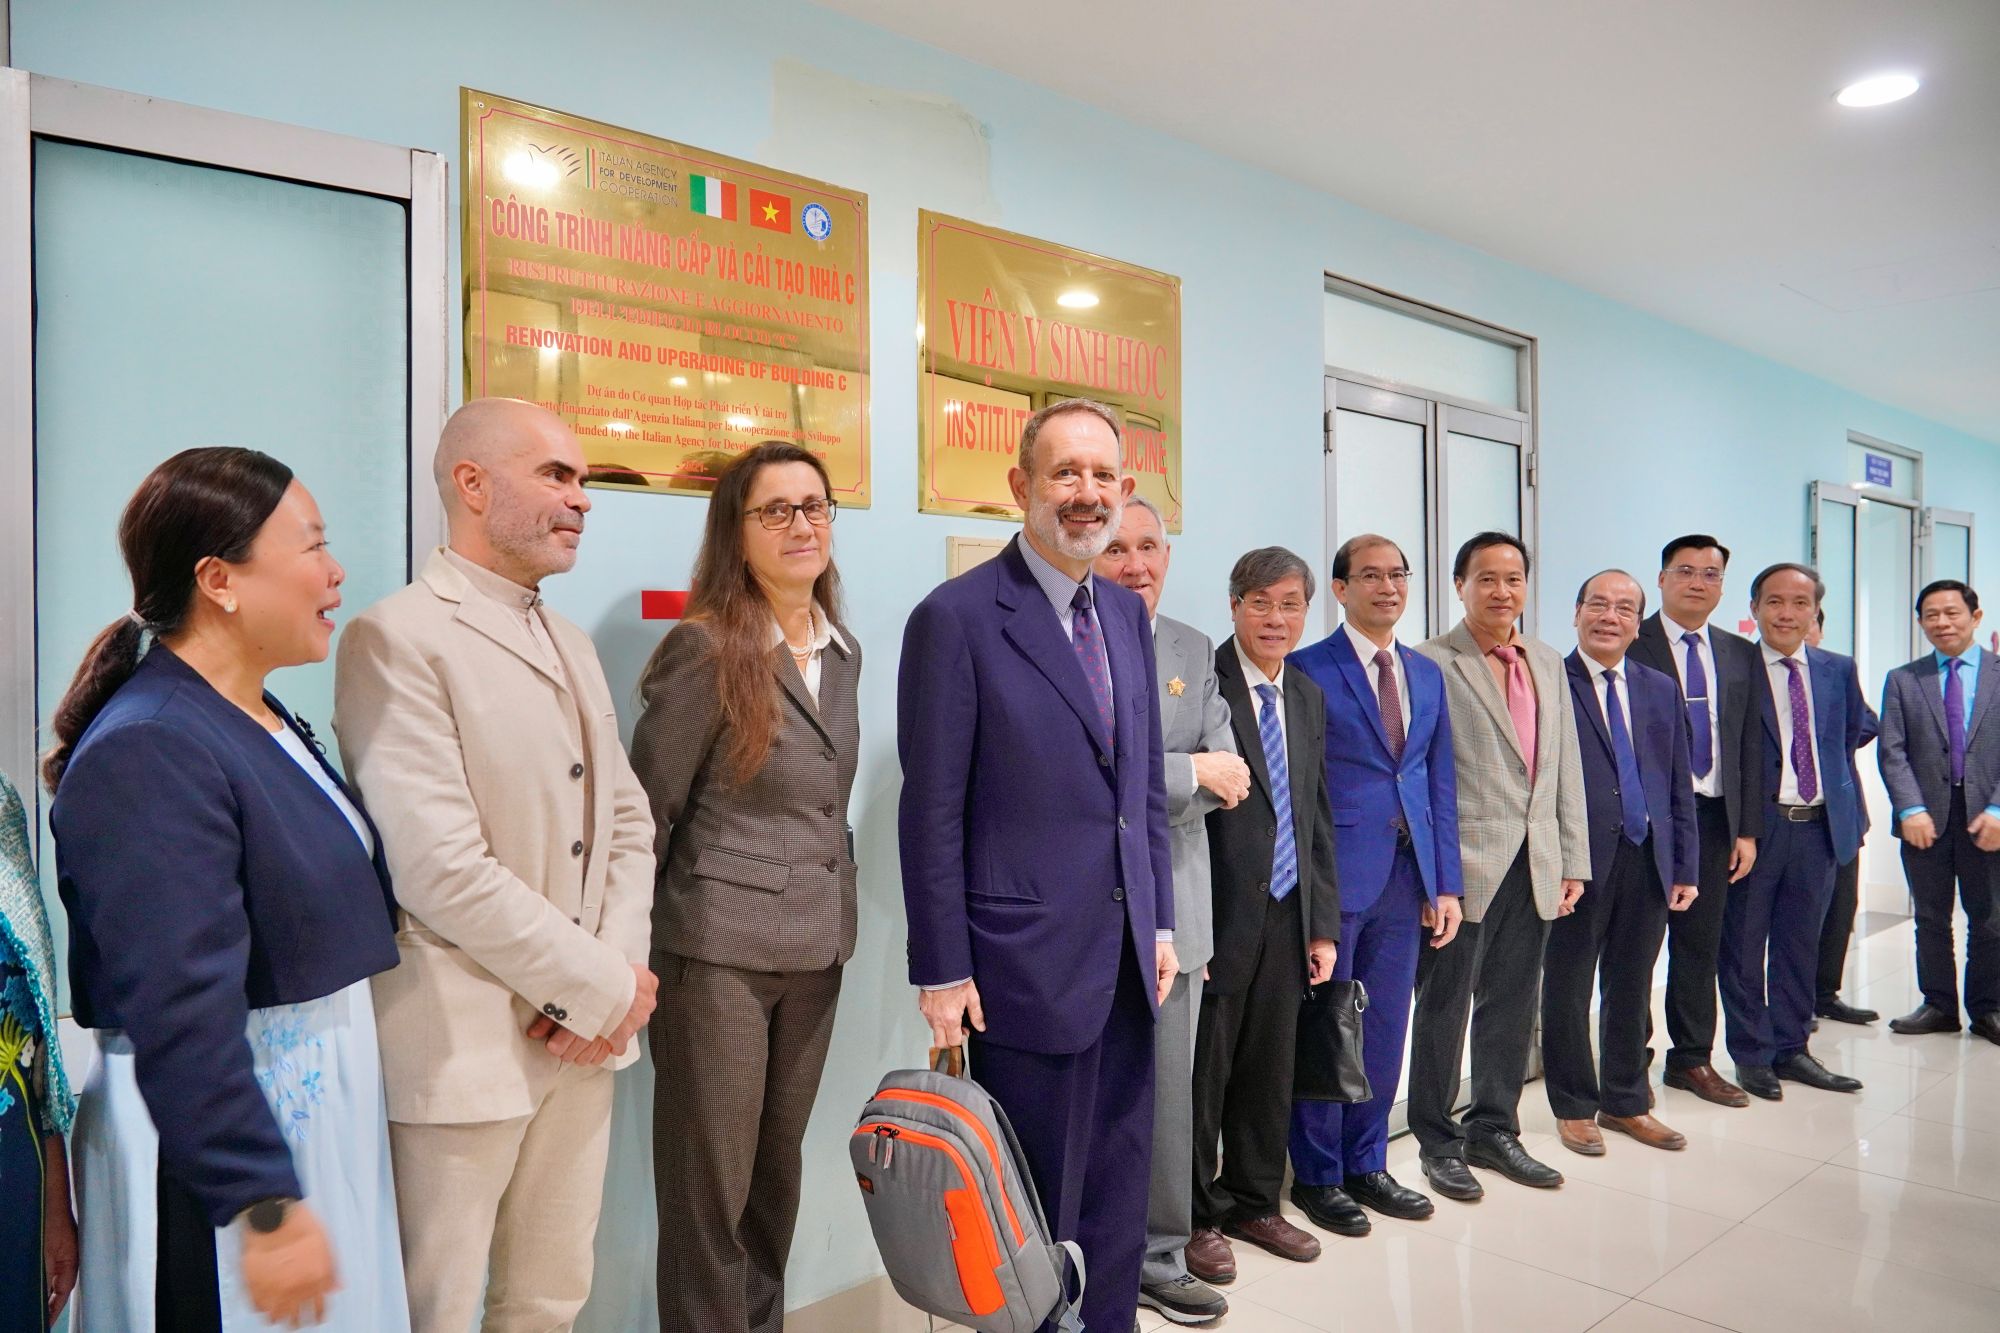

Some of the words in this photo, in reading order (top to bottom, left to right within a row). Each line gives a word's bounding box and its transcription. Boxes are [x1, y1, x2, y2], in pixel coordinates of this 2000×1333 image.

[600, 152, 633, 169] ITALIAN
[636, 161, 677, 179] AGENCY
[600, 167, 615, 178] FOR
[620, 172, 678, 192] DEVELOPMENT
[600, 181, 678, 207] COOPERATION
[491, 194, 549, 246] CÔNG
[555, 209, 613, 258] TRÌNH
[619, 220, 671, 271] NÂNG
[676, 227, 711, 275] CẤP
[717, 240, 739, 282] VÀ
[743, 243, 770, 289] CẢI
[775, 258, 805, 300] TẠO
[809, 264, 841, 303] NHÀ
[845, 273, 855, 305] C
[511, 258, 690, 305] RISTRUTTURAZIONE
[696, 292, 705, 308] E
[711, 296, 843, 333] AGGIORNAMENTO
[705, 319, 770, 346] BLOCCO
[946, 287, 1017, 387] VIỆN
[1023, 315, 1042, 377] Y
[1050, 321, 1110, 390] SINH
[1116, 337, 1167, 412] HỌC
[506, 324, 612, 358] RENOVATION
[618, 342, 652, 363] AND
[658, 347, 744, 376] UPGRADING
[750, 361, 766, 379] OF
[771, 364, 834, 390] BUILDING
[838, 375, 847, 391] C
[587, 384, 601, 400] Dự
[604, 386, 615, 398] án
[618, 388, 630, 400] do
[633, 390, 646, 402] Cơ
[648, 395, 670, 406] quan
[673, 395, 691, 410] Hợp
[695, 398, 707, 410] tác
[709, 399, 729, 414] Phát
[732, 401, 750, 415] triển
[762, 407, 773, 419] tài
[775, 409, 787, 421] trợ
[562, 401, 610, 418] finanziato
[672, 414, 706, 430] Italiana
[708, 421, 722, 432] per
[725, 420, 733, 431] la
[735, 423, 790, 438] Cooperazione
[808, 431, 841, 445] Sviluppo
[574, 423, 608, 438] funded
[611, 426, 622, 440] by
[625, 427, 640, 441] the
[642, 429, 672, 444] Italian
[674, 434, 705, 449] Agency
[708, 437, 721, 449] for
[724, 438, 752, 452] Develo
[1120, 425, 1167, 474] DICINE
